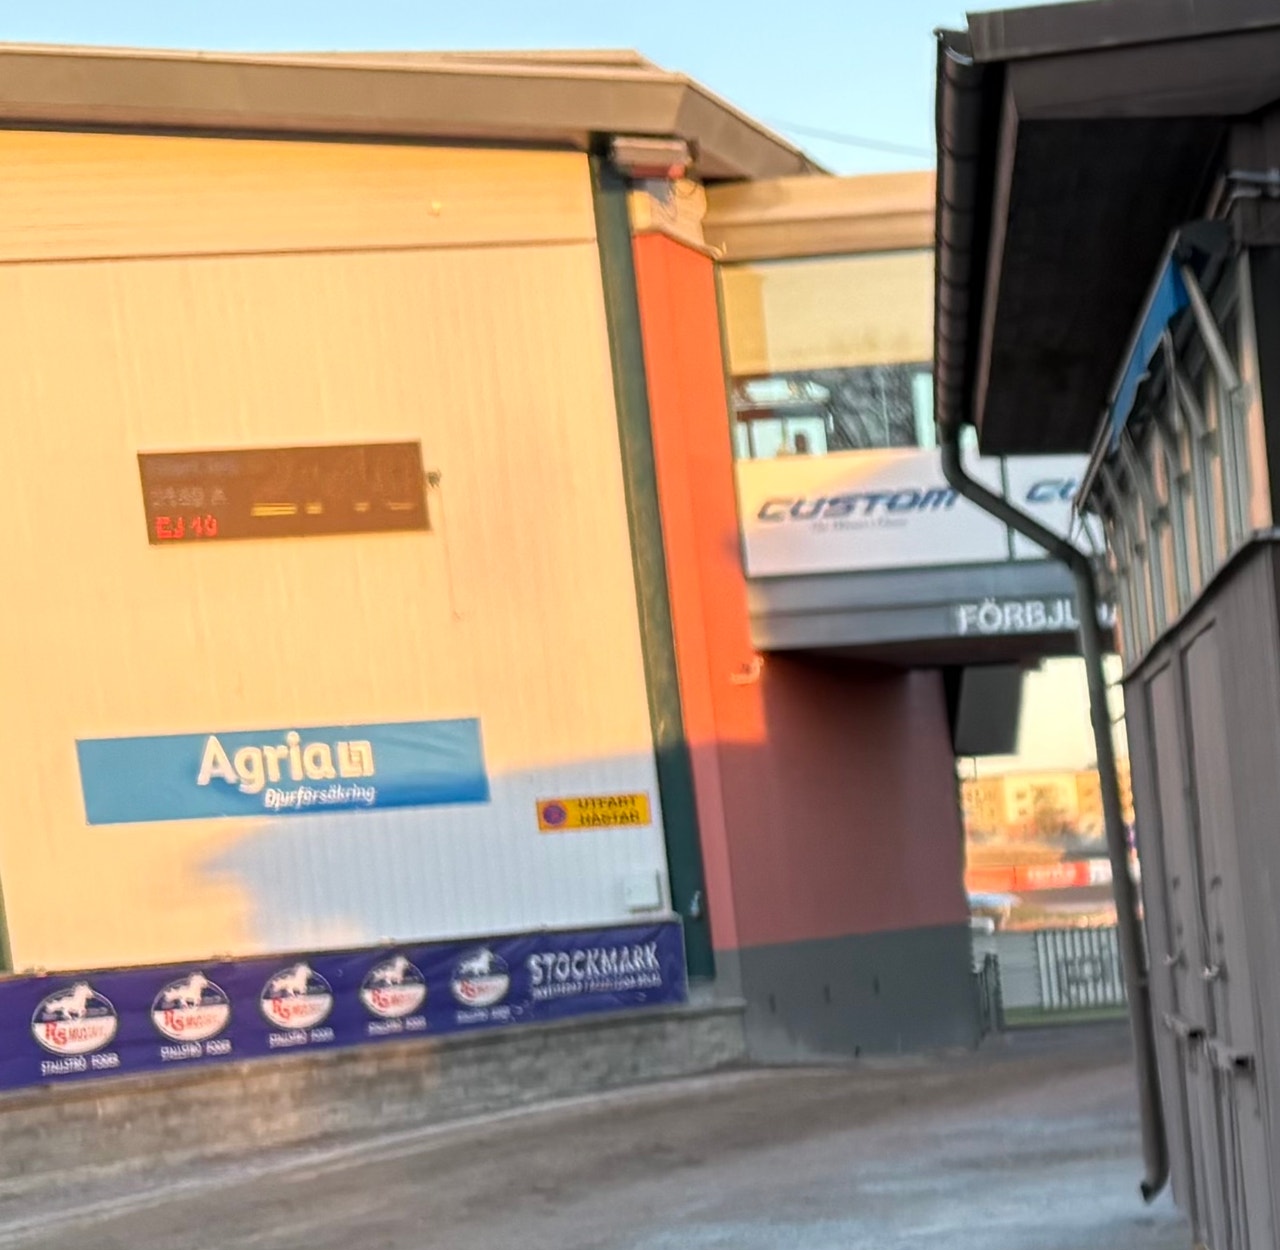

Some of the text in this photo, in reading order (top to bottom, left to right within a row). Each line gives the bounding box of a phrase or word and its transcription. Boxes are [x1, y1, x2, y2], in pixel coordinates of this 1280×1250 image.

[757, 486, 959, 522] CUSTOM
[957, 596, 1117, 636] FÖRBJU
[196, 730, 337, 795] Agria
[264, 783, 377, 811] Djurförsäkring
[528, 941, 662, 986] STOCKMARK
